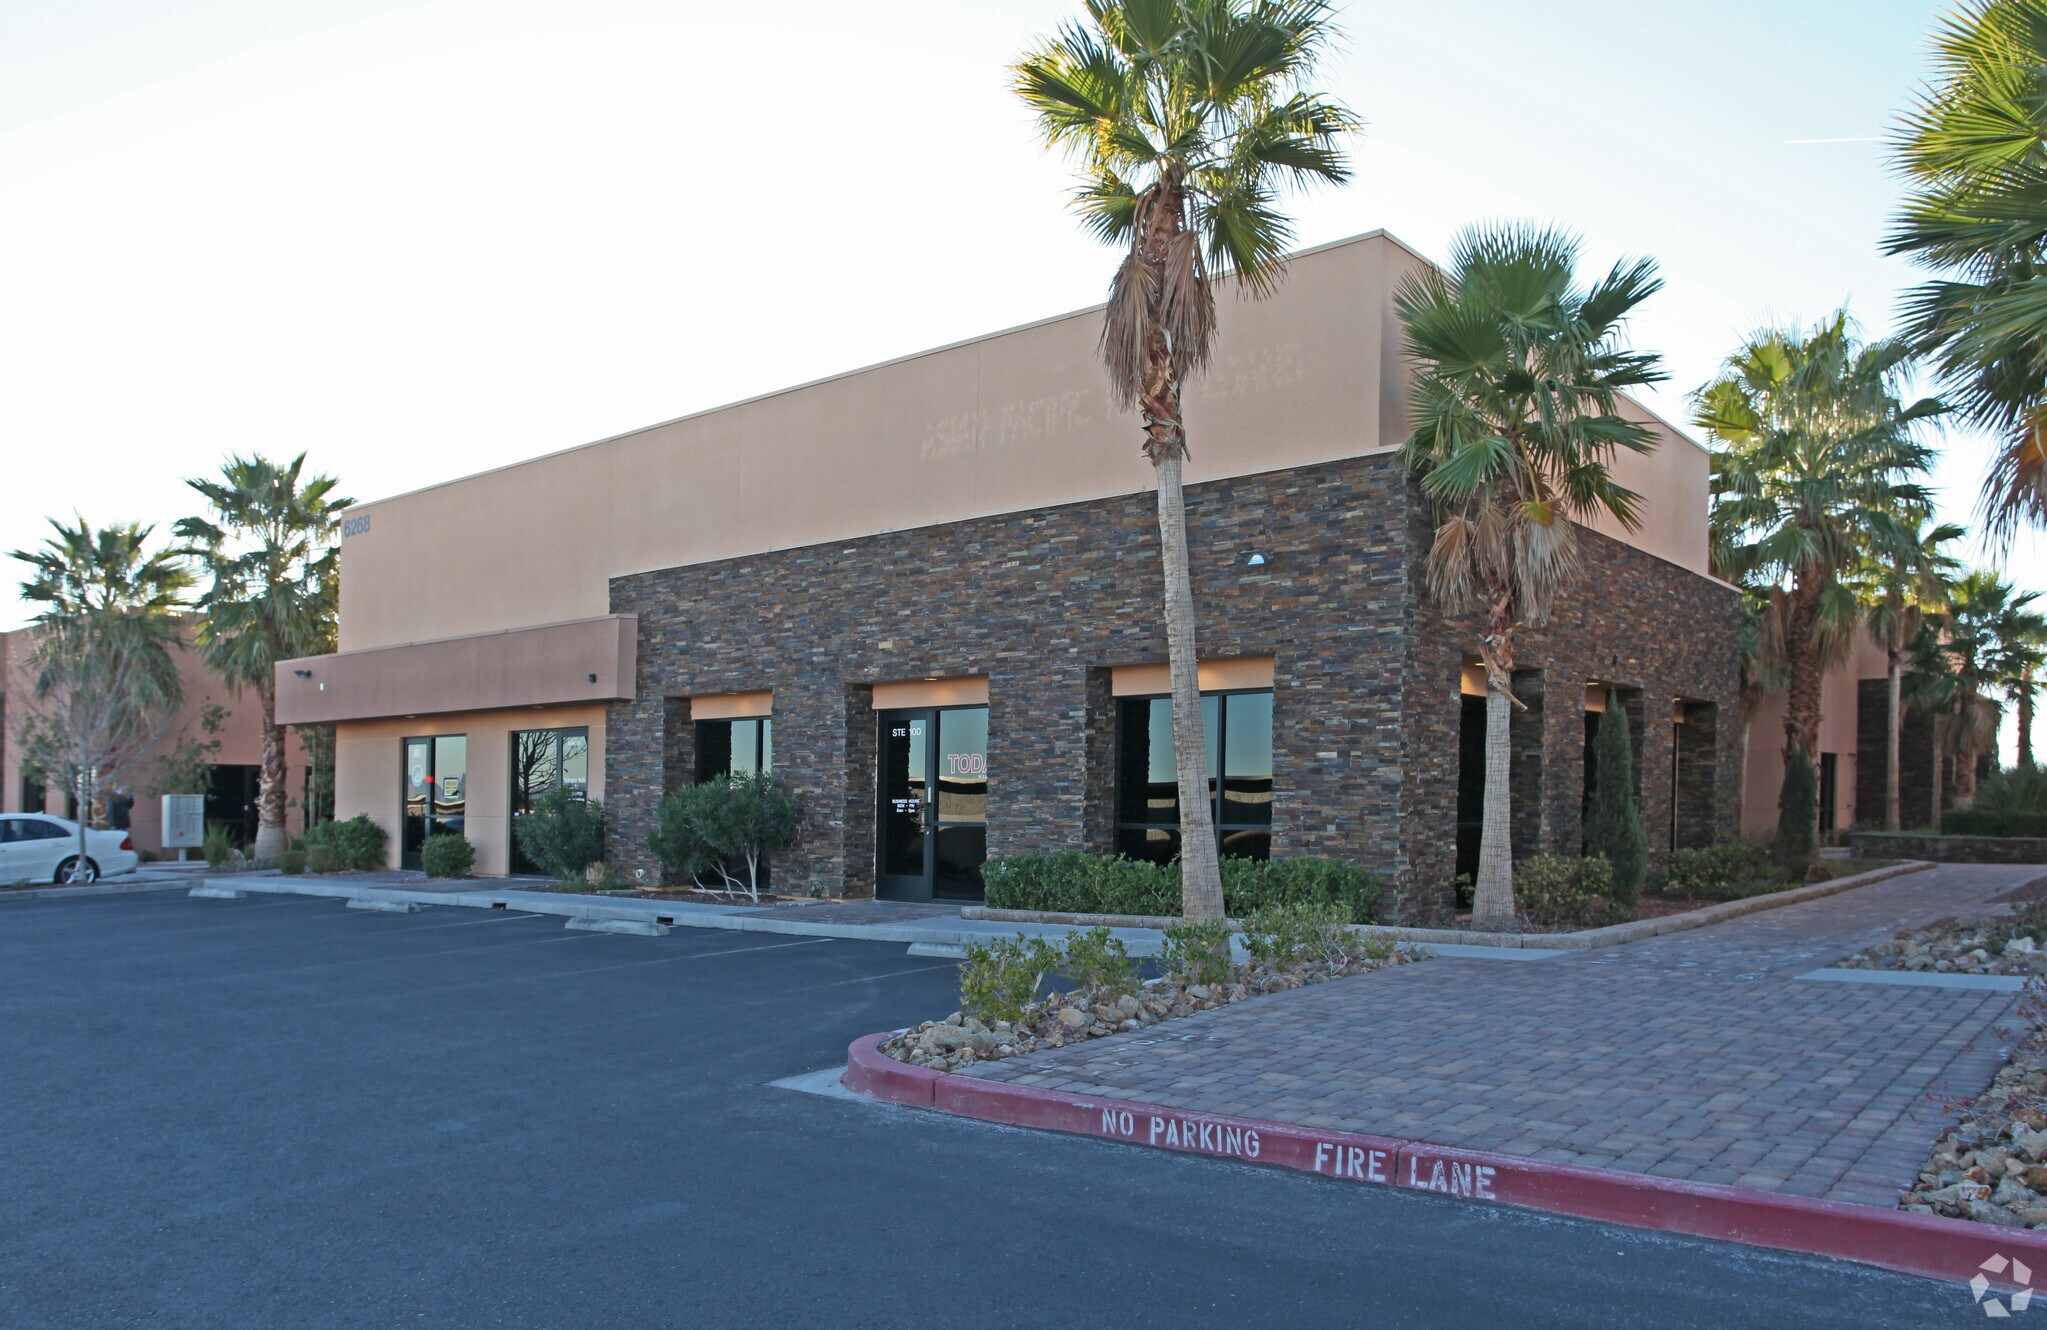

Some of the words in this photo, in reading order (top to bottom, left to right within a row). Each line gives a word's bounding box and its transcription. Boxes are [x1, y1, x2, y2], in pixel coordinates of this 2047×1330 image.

[344, 514, 370, 537] 6268
[892, 728, 906, 737] STE
[909, 728, 922, 736] 100
[1102, 1109, 1134, 1136] NO
[1150, 1116, 1260, 1158] PARKING
[1314, 1142, 1386, 1182] FIRE
[1410, 1156, 1496, 1200] LANE
